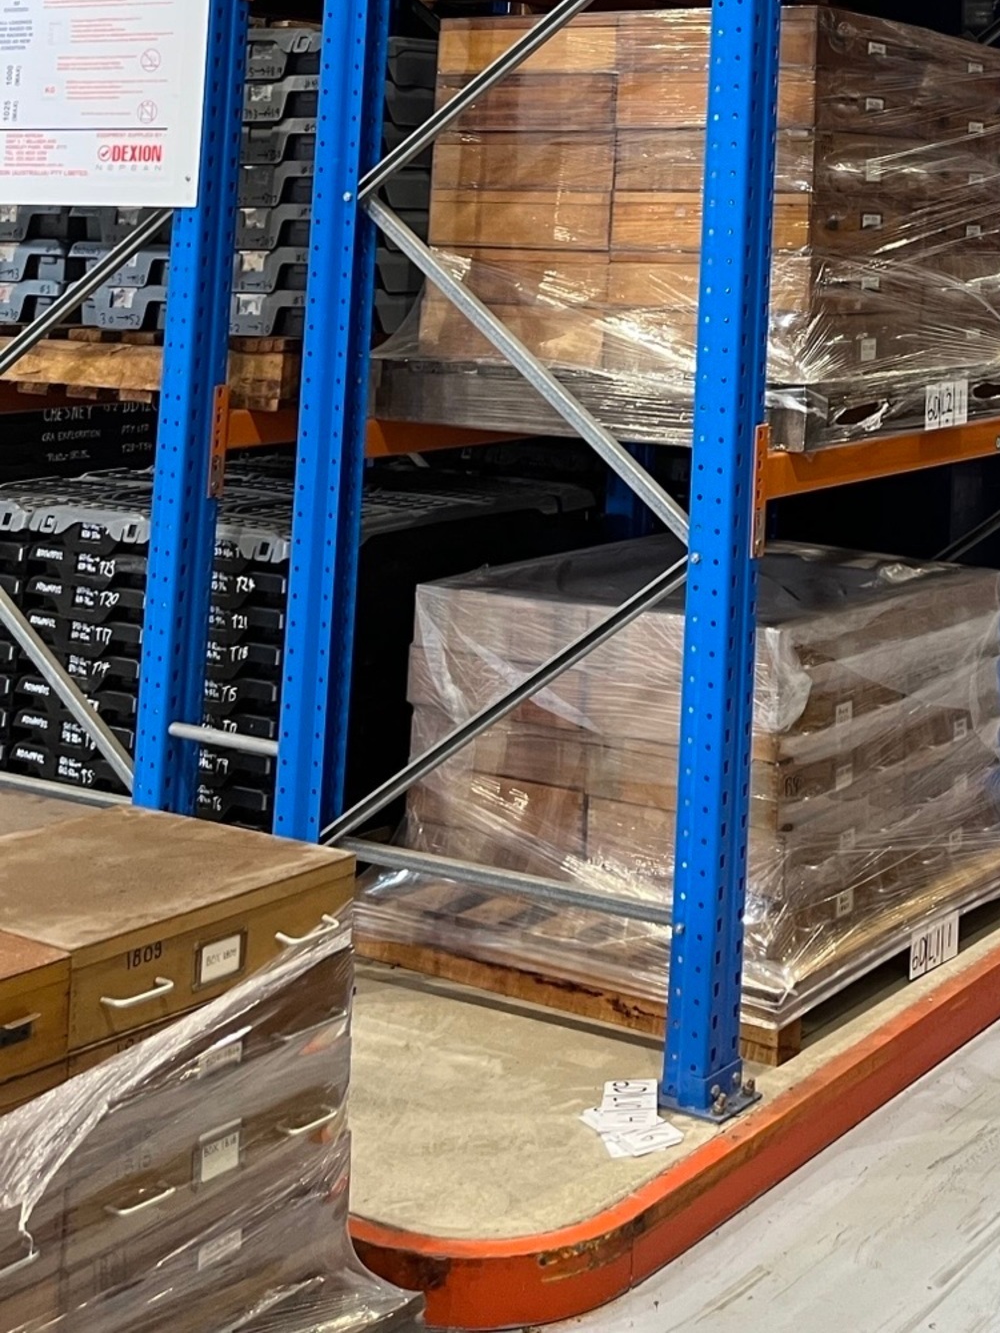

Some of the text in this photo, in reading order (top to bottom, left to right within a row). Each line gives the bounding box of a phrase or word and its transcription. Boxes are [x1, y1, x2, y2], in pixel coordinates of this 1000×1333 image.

[111, 145, 162, 162] DEXION
[100, 590, 120, 608] T20
[231, 613, 248, 630] T21
[126, 941, 163, 971] 1809
[205, 953, 220, 967] BOX
